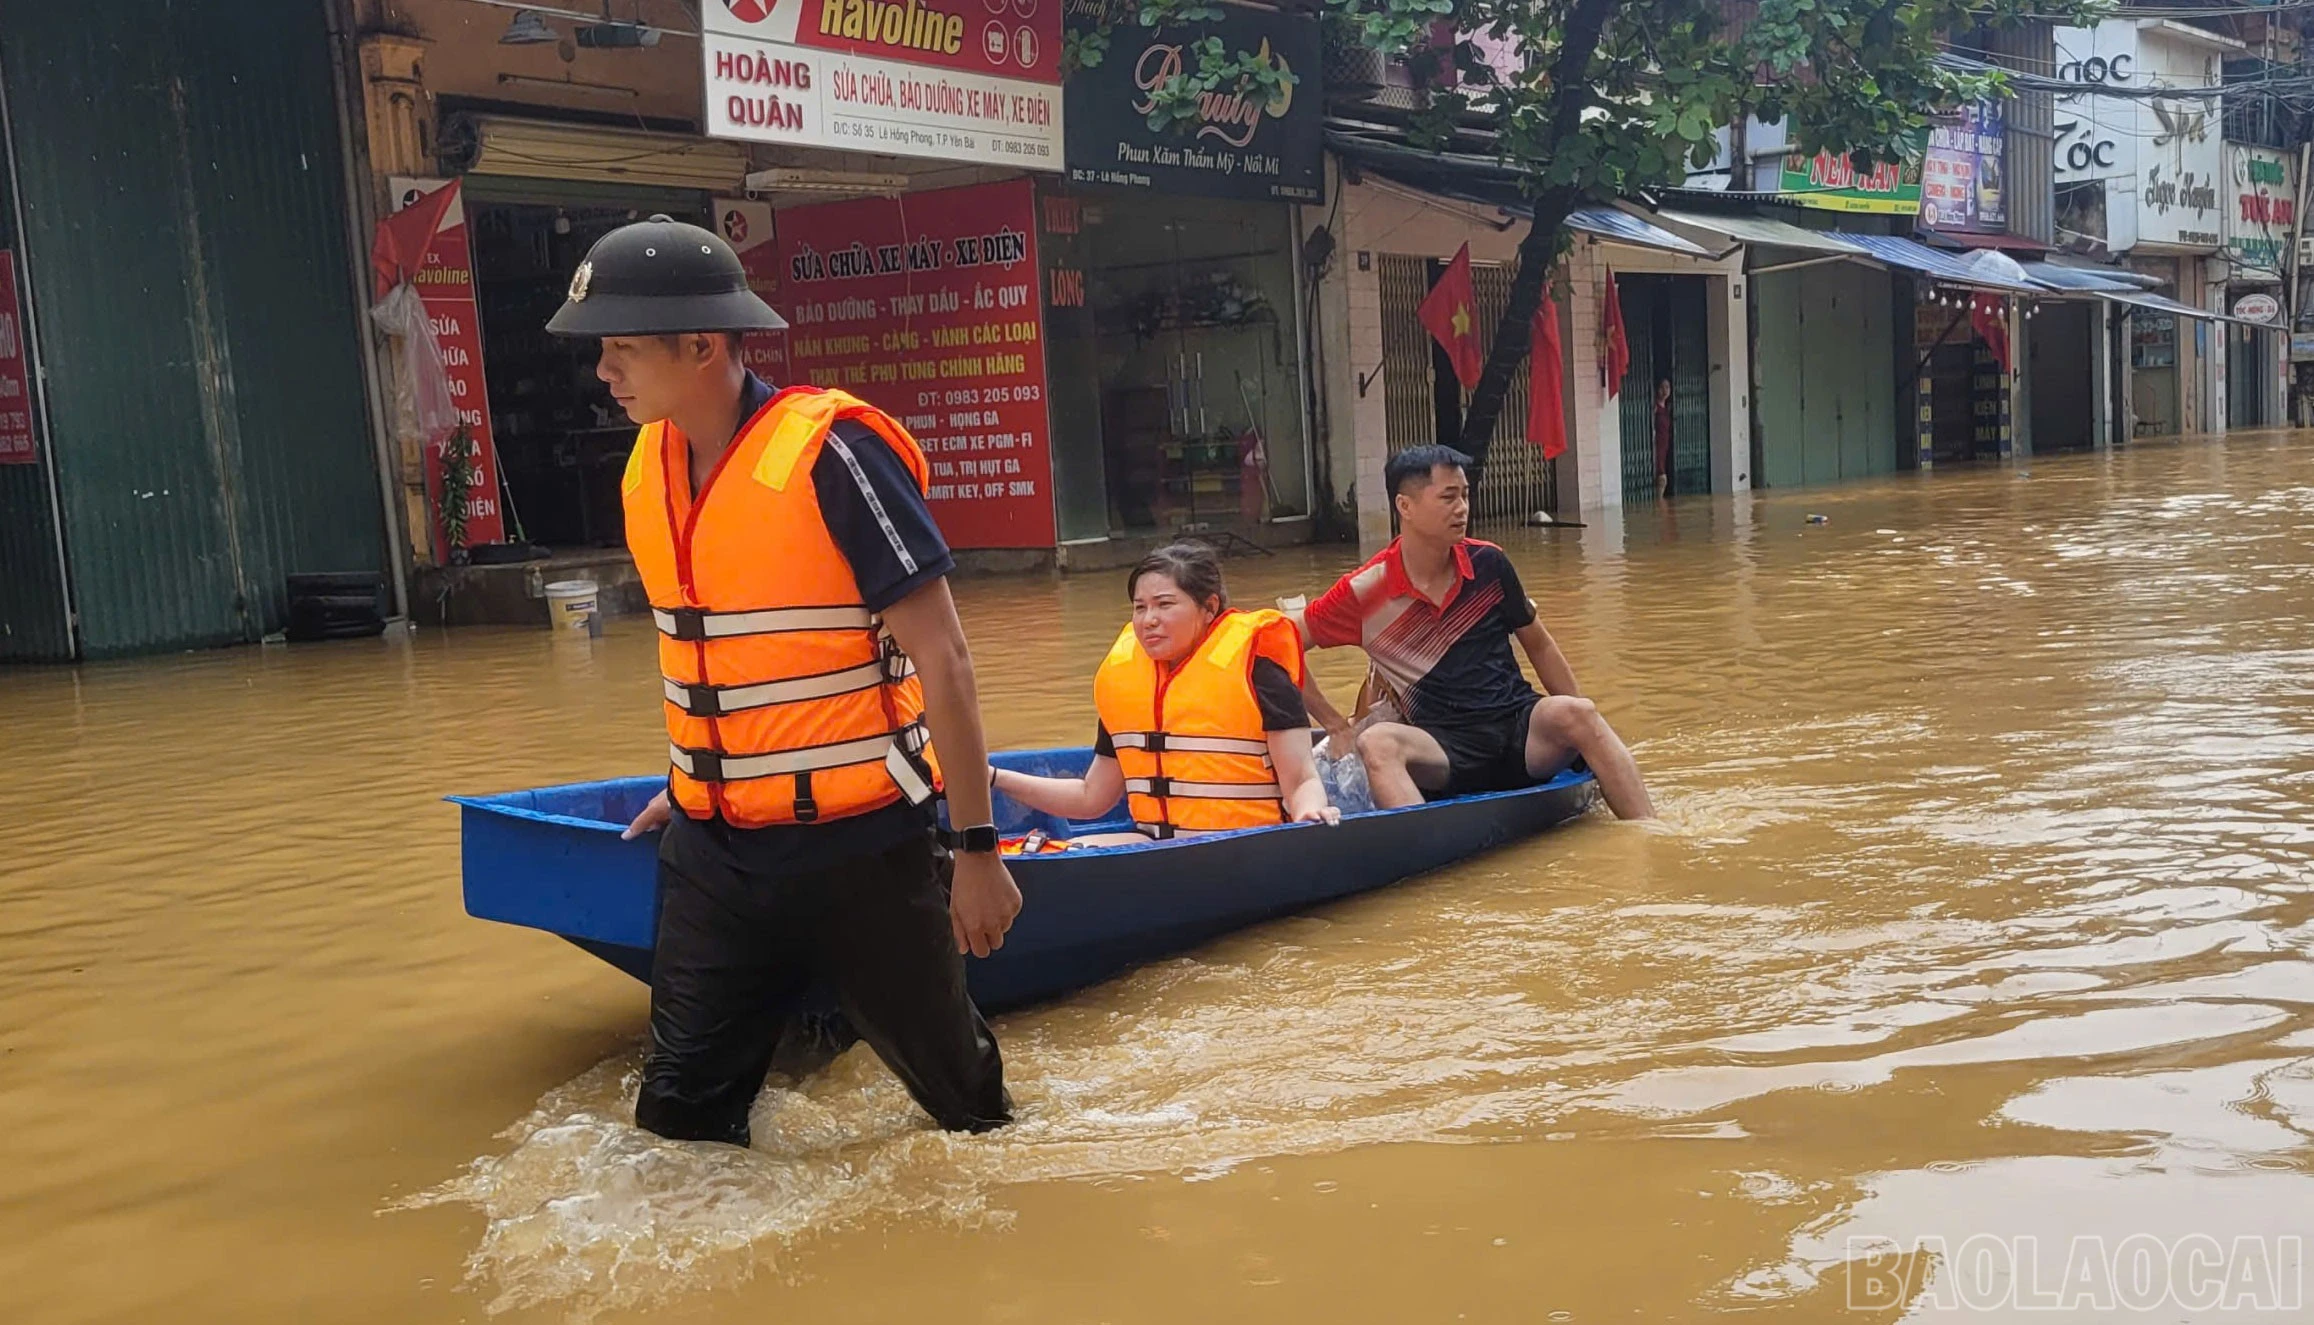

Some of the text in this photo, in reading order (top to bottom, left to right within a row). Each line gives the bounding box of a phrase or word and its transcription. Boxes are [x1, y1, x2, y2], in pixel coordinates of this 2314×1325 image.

[819, 0, 964, 54] Havoline
[715, 50, 811, 90] HOÀNG
[833, 61, 858, 102] SỬA
[900, 71, 921, 111] BẢO
[925, 78, 963, 116] DƯỠNG
[966, 88, 980, 118] XE
[1011, 95, 1025, 123] XE
[1027, 92, 1051, 132] ĐIỆN
[728, 94, 803, 130] QUÂN
[864, 125, 875, 138] 35
[1005, 141, 1021, 154] 0983
[1023, 143, 1036, 156] 205
[1037, 144, 1050, 157] 093
[1117, 141, 1150, 162] Phun
[1152, 145, 1181, 166] Xăm
[1264, 157, 1280, 175] Mi
[1086, 170, 1095, 182] 37
[792, 224, 1026, 282] SỬA CHỮA XE MÁY XE ĐIỆN
[889, 294, 924, 316] THAY
[998, 285, 1028, 309] QUY
[429, 313, 460, 336] SỬA
[932, 324, 969, 347] VÀNH
[973, 321, 1001, 344] CÁC
[1005, 321, 1037, 345] LOẠI
[441, 346, 469, 366] HỮA
[809, 367, 839, 386] THAY
[940, 354, 982, 378] CHÍNH
[448, 374, 467, 396] ẢO
[917, 385, 1040, 407] ĐT: 0983 205 093
[905, 411, 999, 431] PHUN HỌNG GA
[916, 438, 939, 453] SET
[941, 436, 967, 451] ECM
[969, 435, 985, 451] XE
[960, 461, 977, 477] TRỊ
[980, 460, 1001, 477] HỤT
[1004, 459, 1020, 474] GA
[984, 483, 1005, 498] OFF
[1008, 481, 1035, 496] SMK
